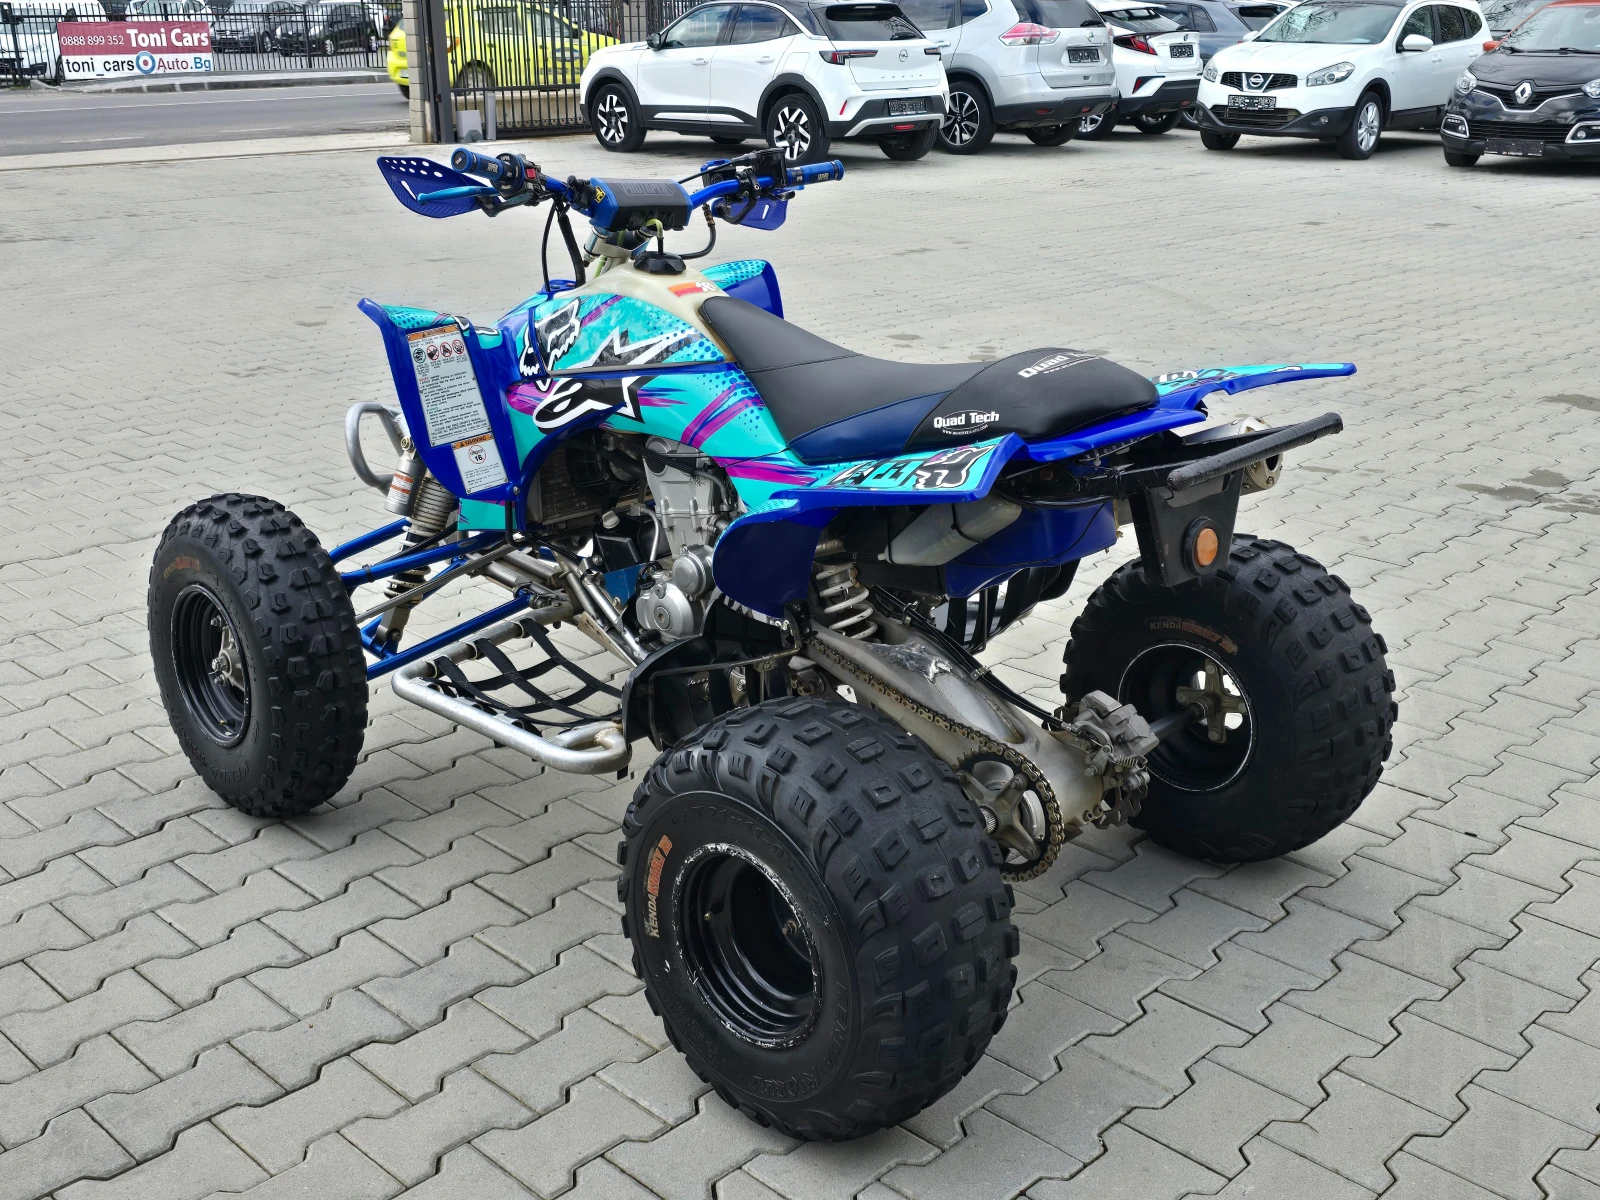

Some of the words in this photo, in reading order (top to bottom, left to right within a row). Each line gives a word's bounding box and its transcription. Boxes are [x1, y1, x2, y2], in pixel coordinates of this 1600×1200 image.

[60, 36, 86, 46] 0888
[87, 36, 105, 46] 899
[107, 35, 125, 46] 352
[126, 28, 167, 47] Toni
[170, 28, 209, 47] Cars
[1018, 355, 1070, 378] Quad
[933, 413, 966, 428] Quad
[969, 411, 1000, 424] Tech
[1149, 621, 1182, 631] KENDA
[648, 893, 660, 939] KENDA
